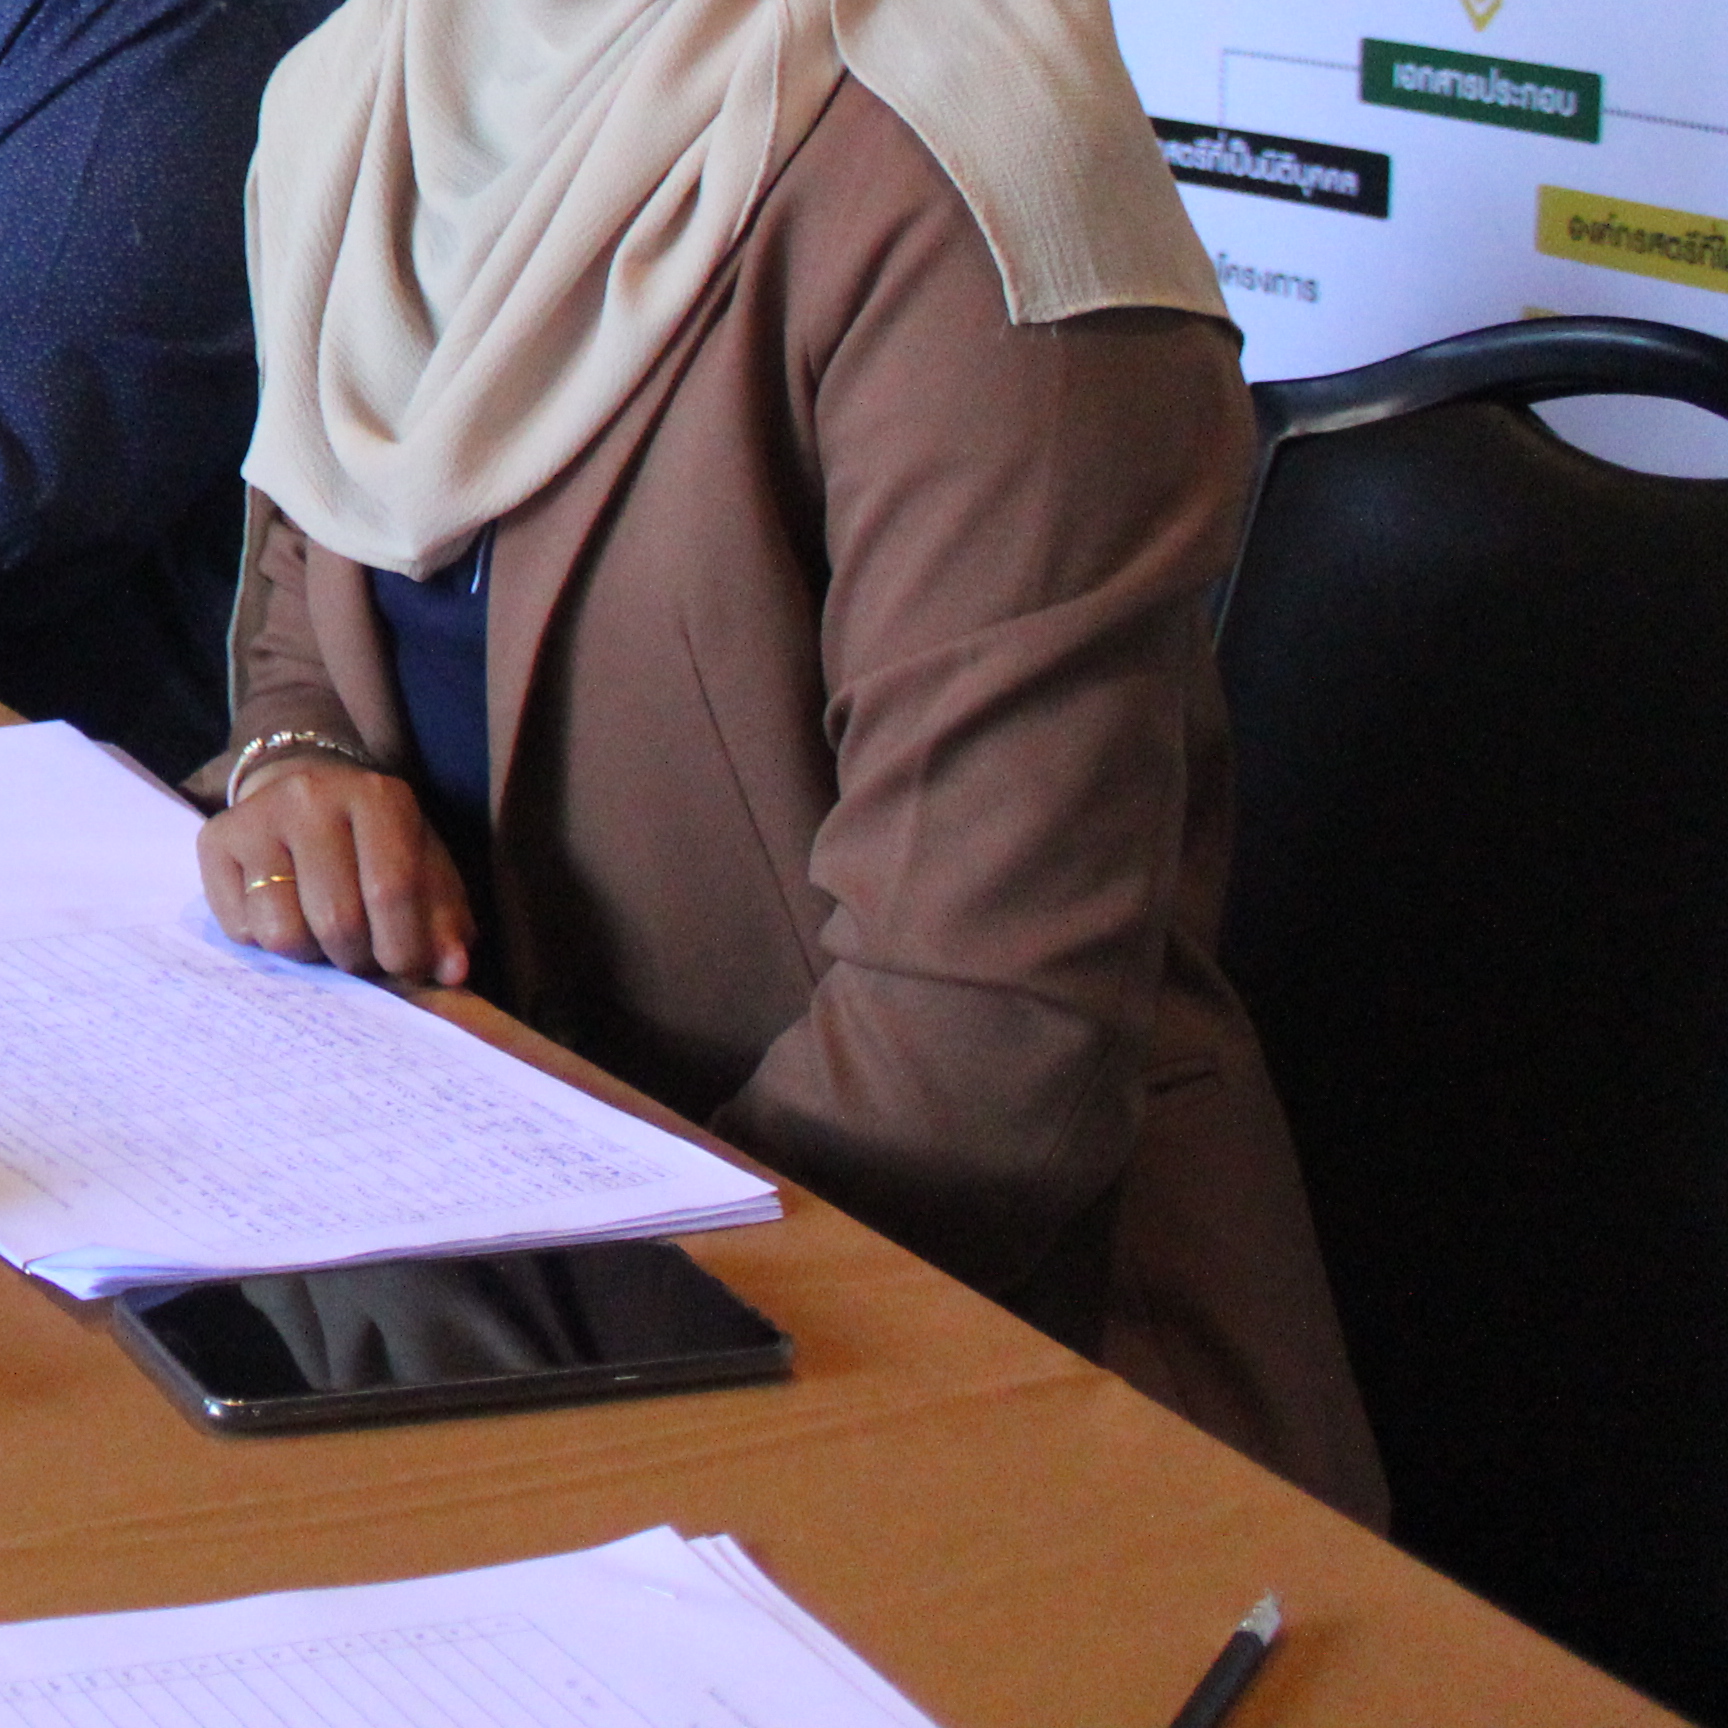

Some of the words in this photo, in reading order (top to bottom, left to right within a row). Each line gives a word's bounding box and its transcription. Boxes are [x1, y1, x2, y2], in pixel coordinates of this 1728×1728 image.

[1393, 62, 1578, 118] เอกสารประกอบ
